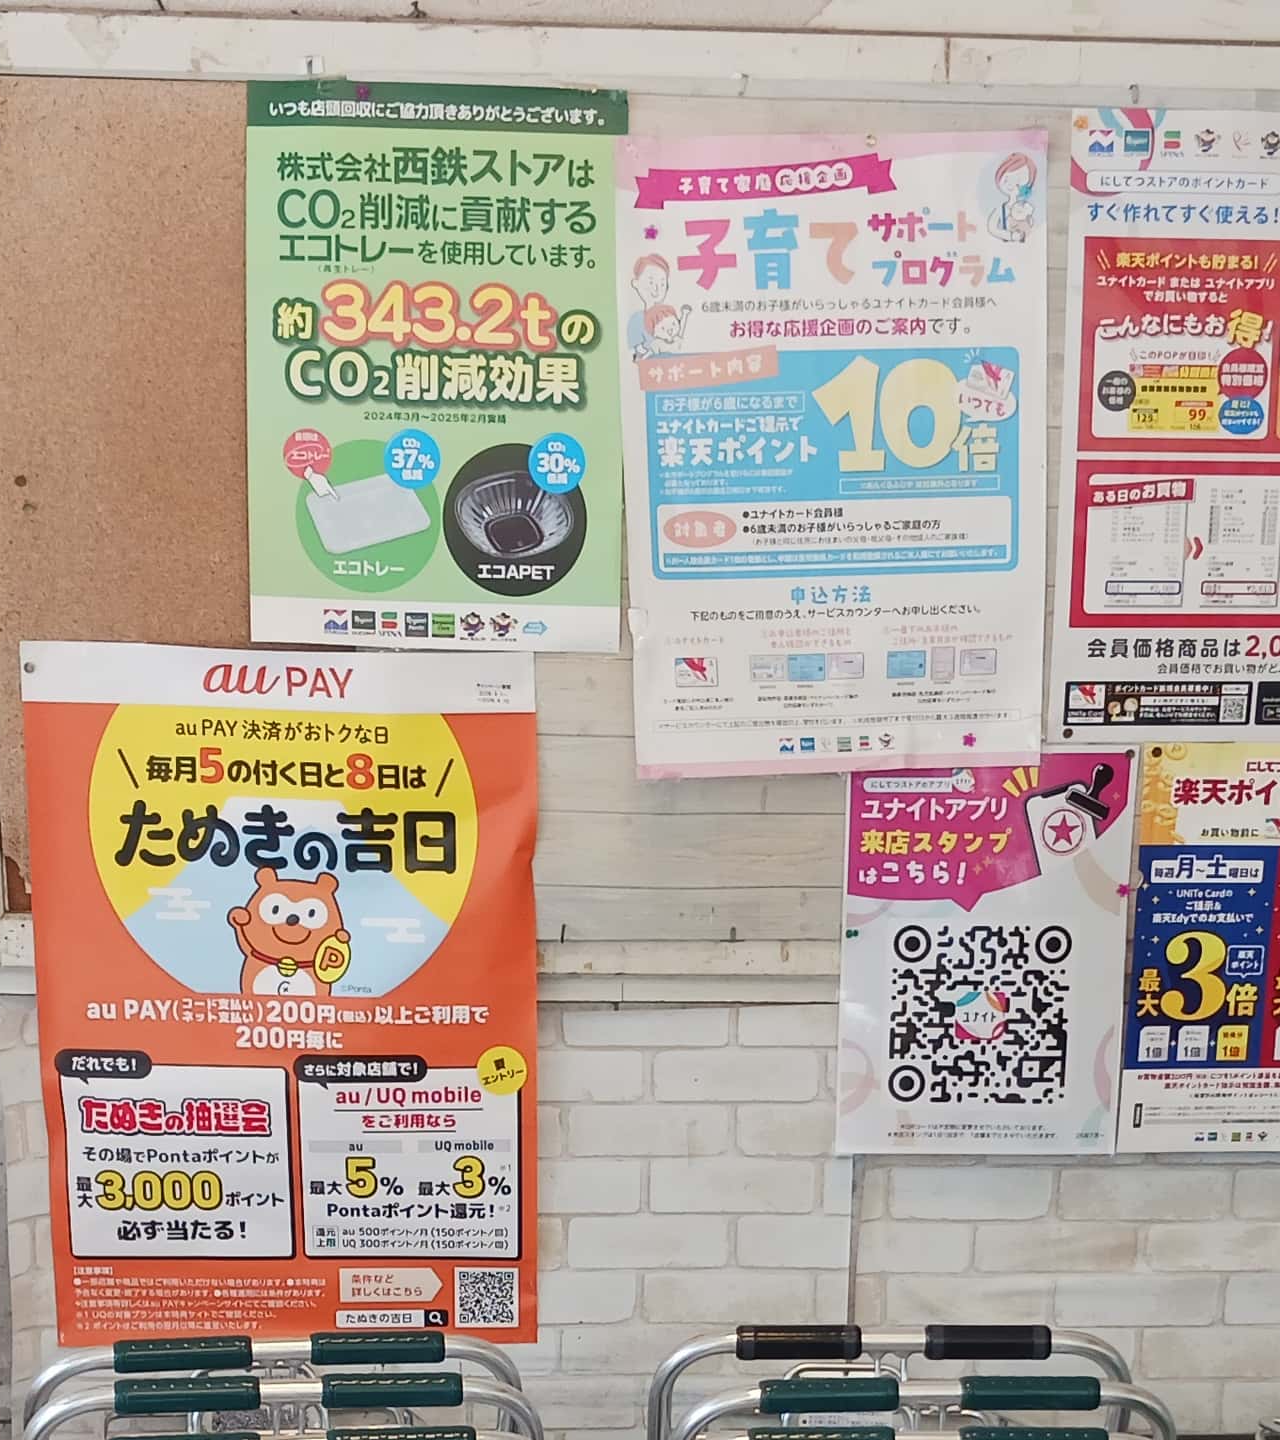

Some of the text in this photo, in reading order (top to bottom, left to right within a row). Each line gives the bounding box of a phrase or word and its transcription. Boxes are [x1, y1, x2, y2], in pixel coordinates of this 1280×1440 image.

[276, 145, 595, 188] 株式会社西鉄ストアは
[1100, 174, 1269, 190] にしてつストアのポイントカード
[277, 188, 597, 235] CO2削減に貢献する
[1087, 203, 1280, 225] すぐ作れてすぐ使える！
[278, 234, 596, 269] エコトレーを使用しています。
[677, 207, 977, 291] 子育て サポート
[872, 250, 1016, 288] プログラム
[1096, 275, 1165, 288] ユナイトカード
[1204, 277, 1275, 290] ユナイトアプリ
[276, 281, 596, 347] 約343.2tの
[729, 318, 972, 339] お得な応援企画のご案内です。
[1099, 309, 1274, 349] こんなにもお得！
[288, 350, 581, 404] CO2削減効果
[658, 354, 1001, 473] 楽天ポイント 10 倍
[391, 449, 435, 470] 37%
[536, 452, 580, 474] 30%
[1092, 481, 1187, 504] ある日のお買物
[333, 559, 405, 577] エコトレー
[477, 564, 555, 581] エコAPET
[791, 585, 872, 605] 申込方法
[202, 663, 353, 699] au PAY
[175, 719, 389, 745] au PAY 決済がおトクな日
[146, 747, 427, 790] 毎月5の付く日と8日は
[860, 797, 1008, 822] ユナイトアプリ
[113, 799, 457, 875] たぬきの吉日
[860, 826, 1013, 855] 来店スタンプ
[858, 861, 968, 885] はこちら！
[1136, 930, 1259, 1021] 最大 3 倍
[87, 1002, 118, 1021] au
[235, 1027, 344, 1049] 200円毎に
[71, 1056, 137, 1074] だれでも！
[335, 1089, 360, 1104] au
[376, 1087, 407, 1107] UQ
[411, 1086, 483, 1104] mobile
[78, 1097, 272, 1137] たぬきの抽選会
[361, 1113, 457, 1129] をご利用なら
[82, 1146, 280, 1165] その場でPontaポイントが
[434, 1140, 495, 1152] UQ mobile
[95, 1169, 223, 1212] 3,000
[225, 1191, 286, 1208] ポイント
[116, 1219, 249, 1241] 必ず当たる！
[345, 1312, 413, 1325] たぬきの吉日
